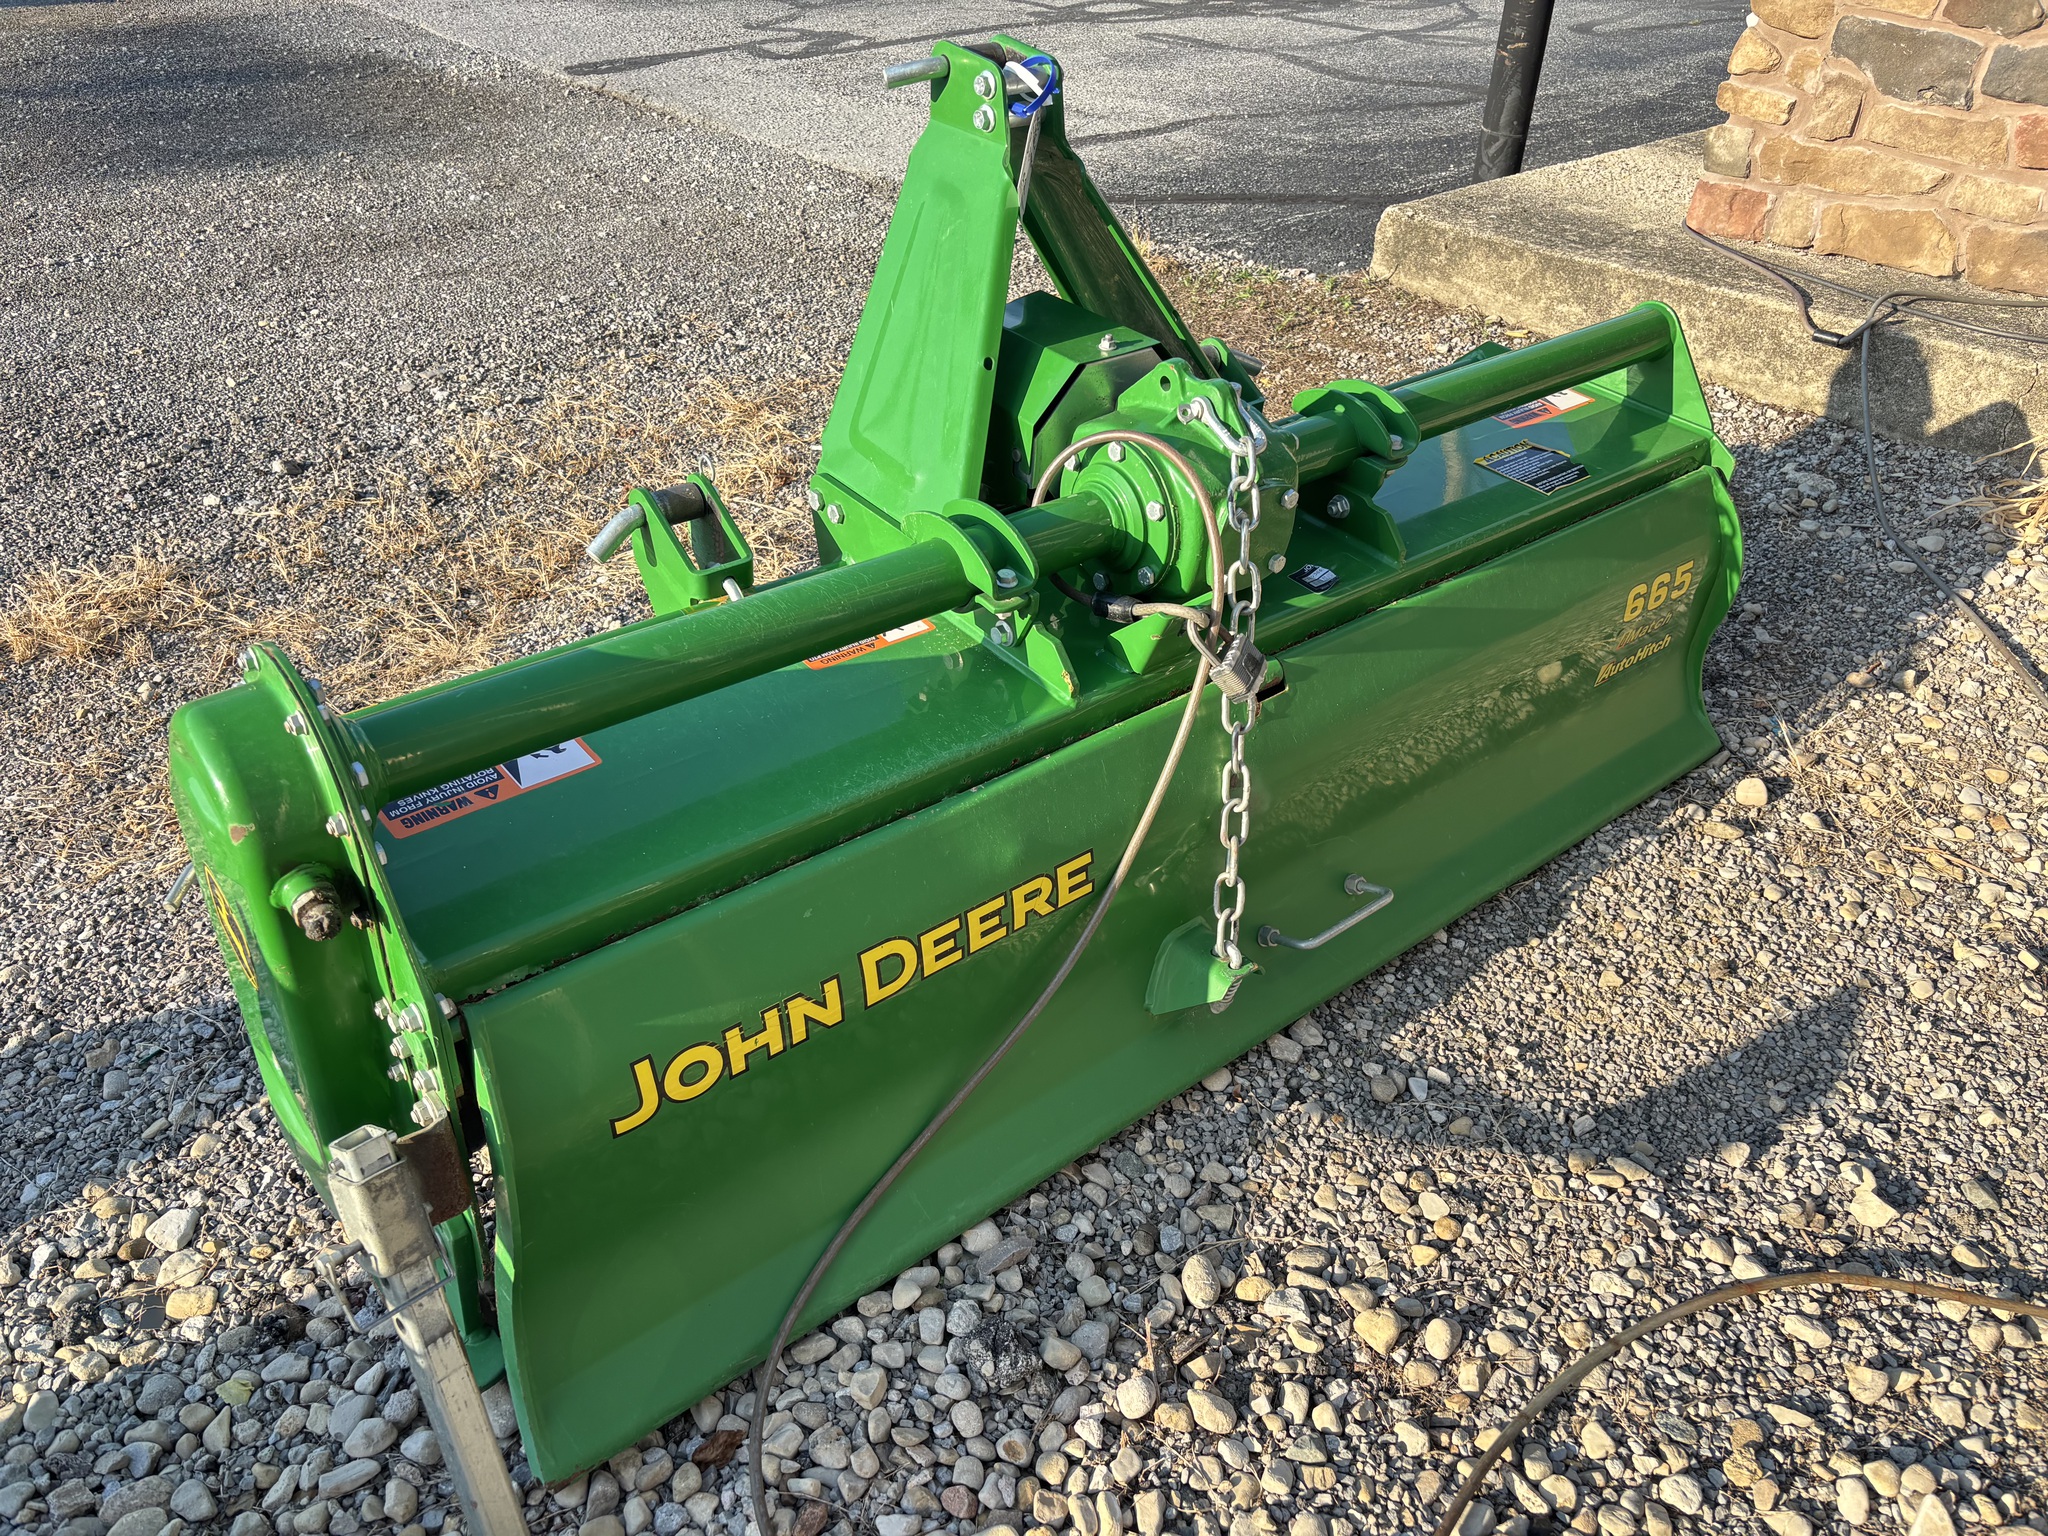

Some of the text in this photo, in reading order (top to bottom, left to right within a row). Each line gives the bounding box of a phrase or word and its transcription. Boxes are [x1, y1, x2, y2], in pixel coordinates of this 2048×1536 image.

[1490, 440, 1528, 460] CAUTION
[1623, 559, 1694, 623] 665
[821, 647, 866, 665] WARNING
[1595, 633, 1672, 687] AutoHitch
[389, 772, 498, 818] AVOID INJURY FROM
[397, 767, 495, 806] ROTATING KNIVES
[401, 796, 474, 829] WARNING
[609, 848, 1095, 1139] JOHN DEERE
